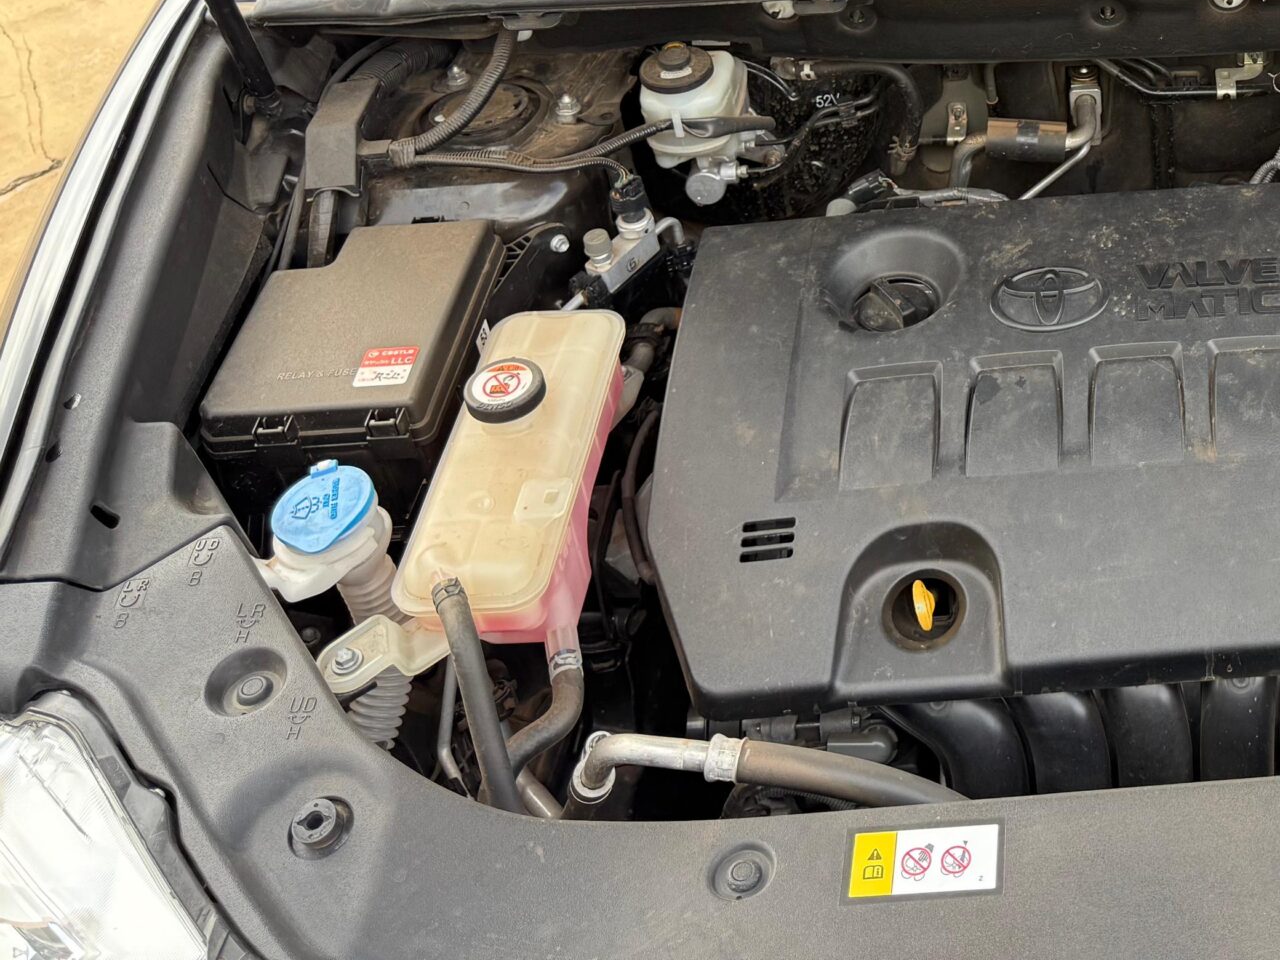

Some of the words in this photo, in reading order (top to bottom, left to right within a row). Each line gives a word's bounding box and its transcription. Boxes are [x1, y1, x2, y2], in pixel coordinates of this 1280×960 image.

[1136, 257, 1280, 290] VALVE
[276, 370, 314, 381] RELAY
[327, 367, 358, 378] FUSE
